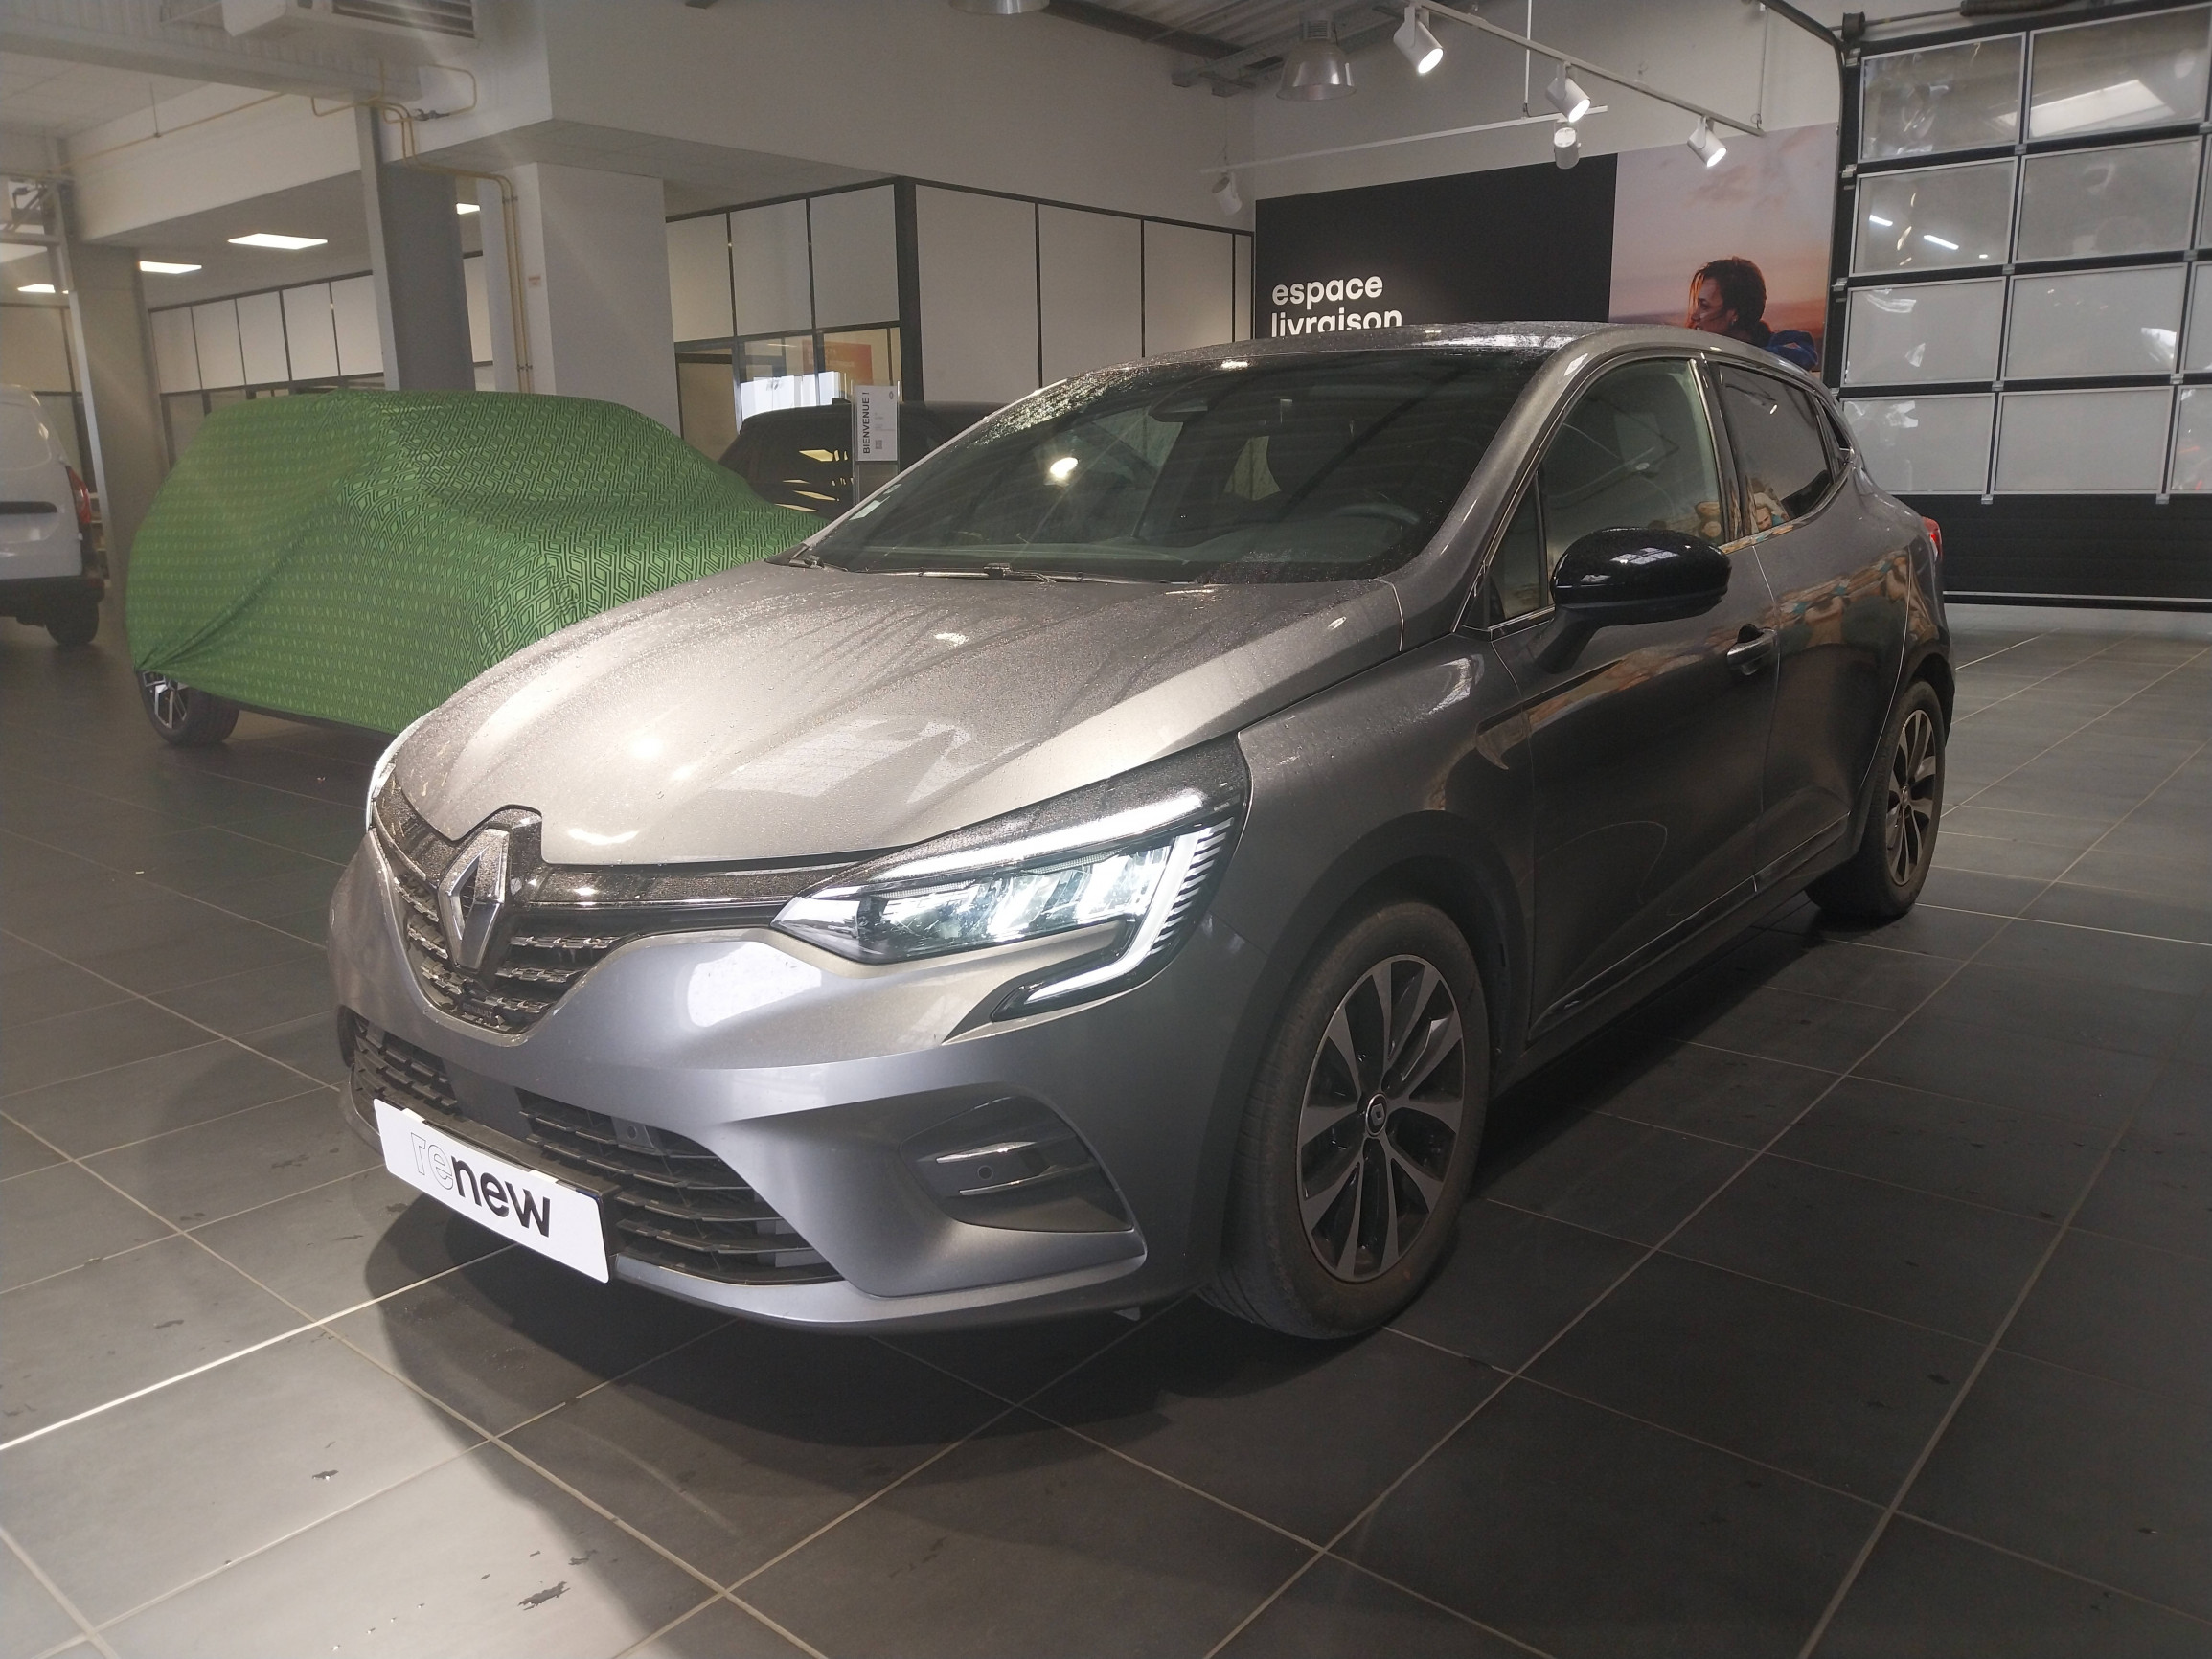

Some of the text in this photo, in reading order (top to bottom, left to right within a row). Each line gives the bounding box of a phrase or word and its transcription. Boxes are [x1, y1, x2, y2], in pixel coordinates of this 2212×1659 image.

[1272, 276, 1383, 310] espace
[1271, 307, 1402, 338] livraison
[862, 398, 871, 454] BIENVENUE
[410, 1132, 551, 1238] renew
